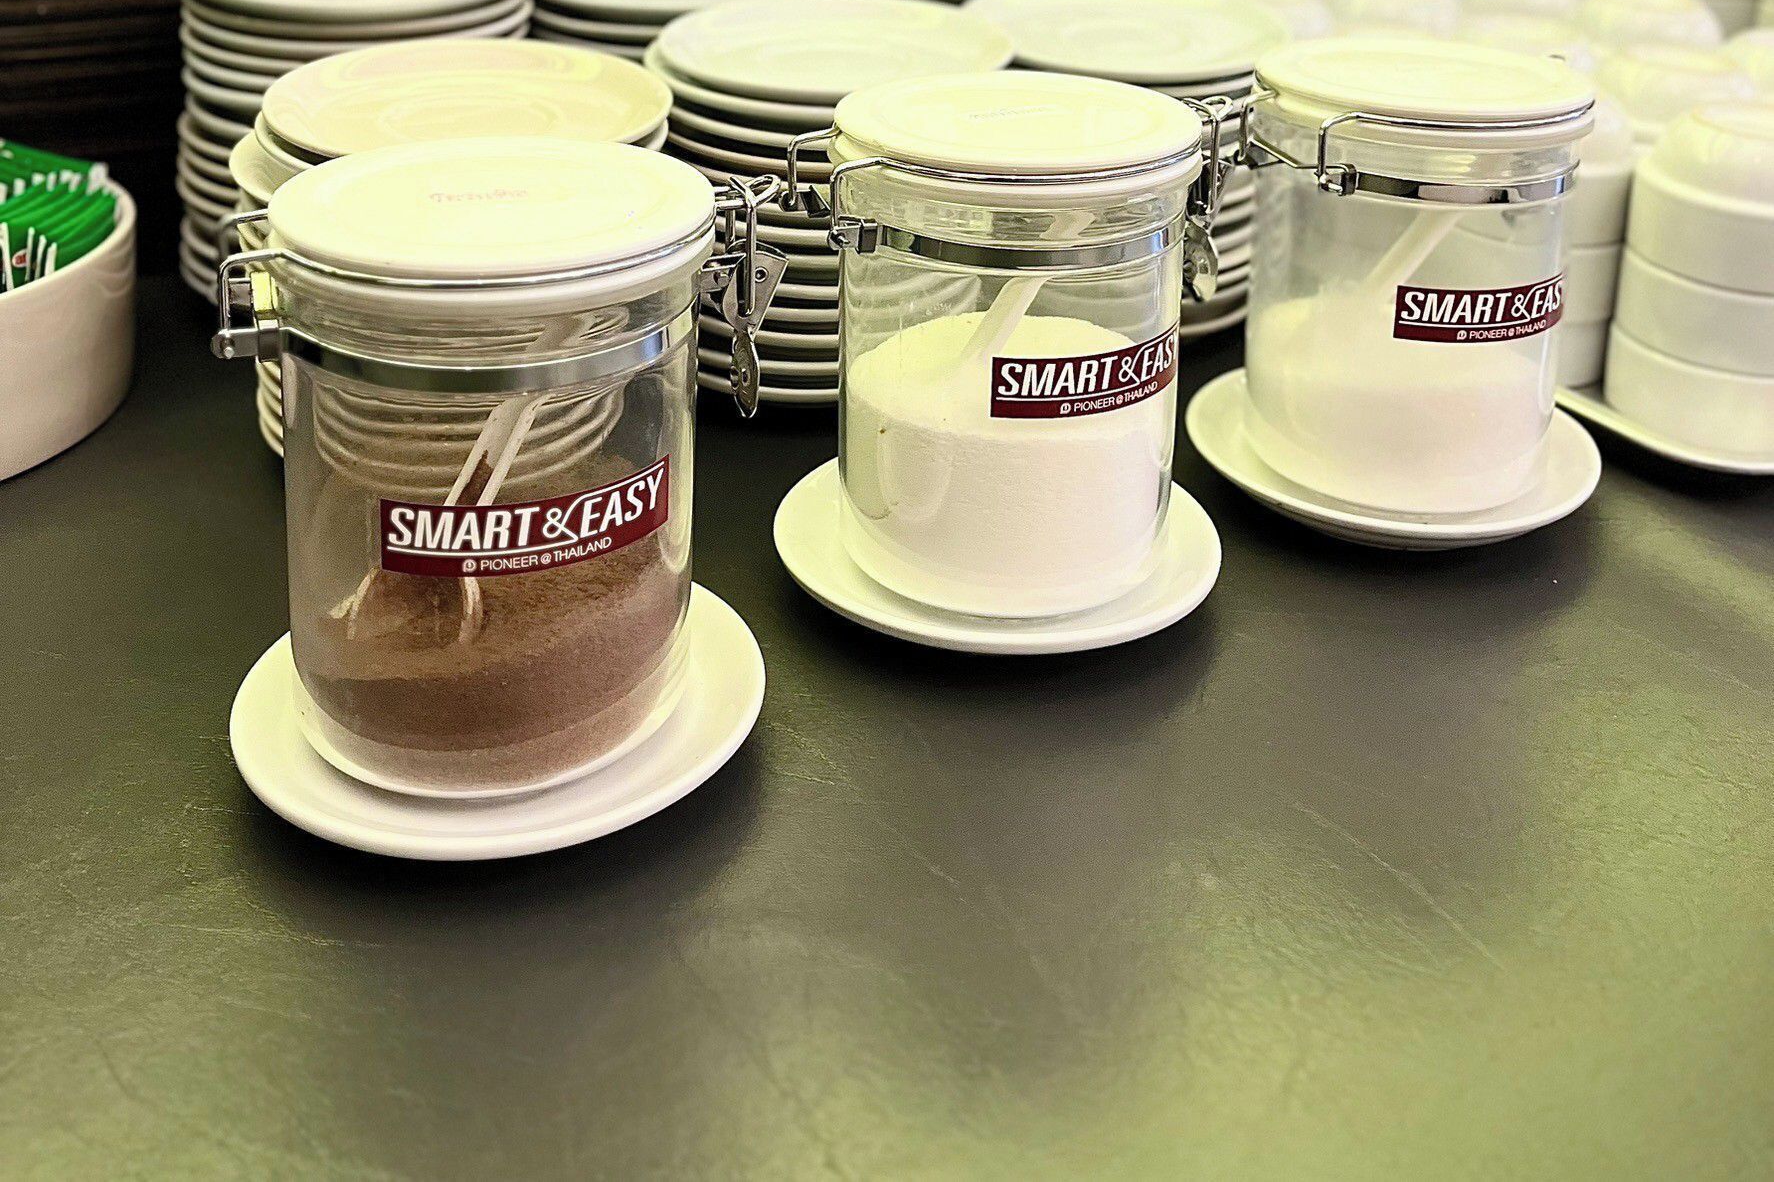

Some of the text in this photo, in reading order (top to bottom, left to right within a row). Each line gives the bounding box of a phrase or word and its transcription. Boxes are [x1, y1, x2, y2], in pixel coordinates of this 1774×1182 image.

[1401, 290, 1512, 324] SMART
[1531, 280, 1564, 319] EAS
[1468, 328, 1508, 341] PIONEER
[1515, 318, 1548, 337] THAILAND
[997, 355, 1119, 397] SMART
[1073, 398, 1116, 413] PIONEER
[1123, 381, 1159, 403] THAILAND
[387, 506, 541, 550] SMART
[578, 468, 665, 539] EASY
[479, 554, 539, 571] PIONEER
[554, 535, 613, 562] THAILAND
